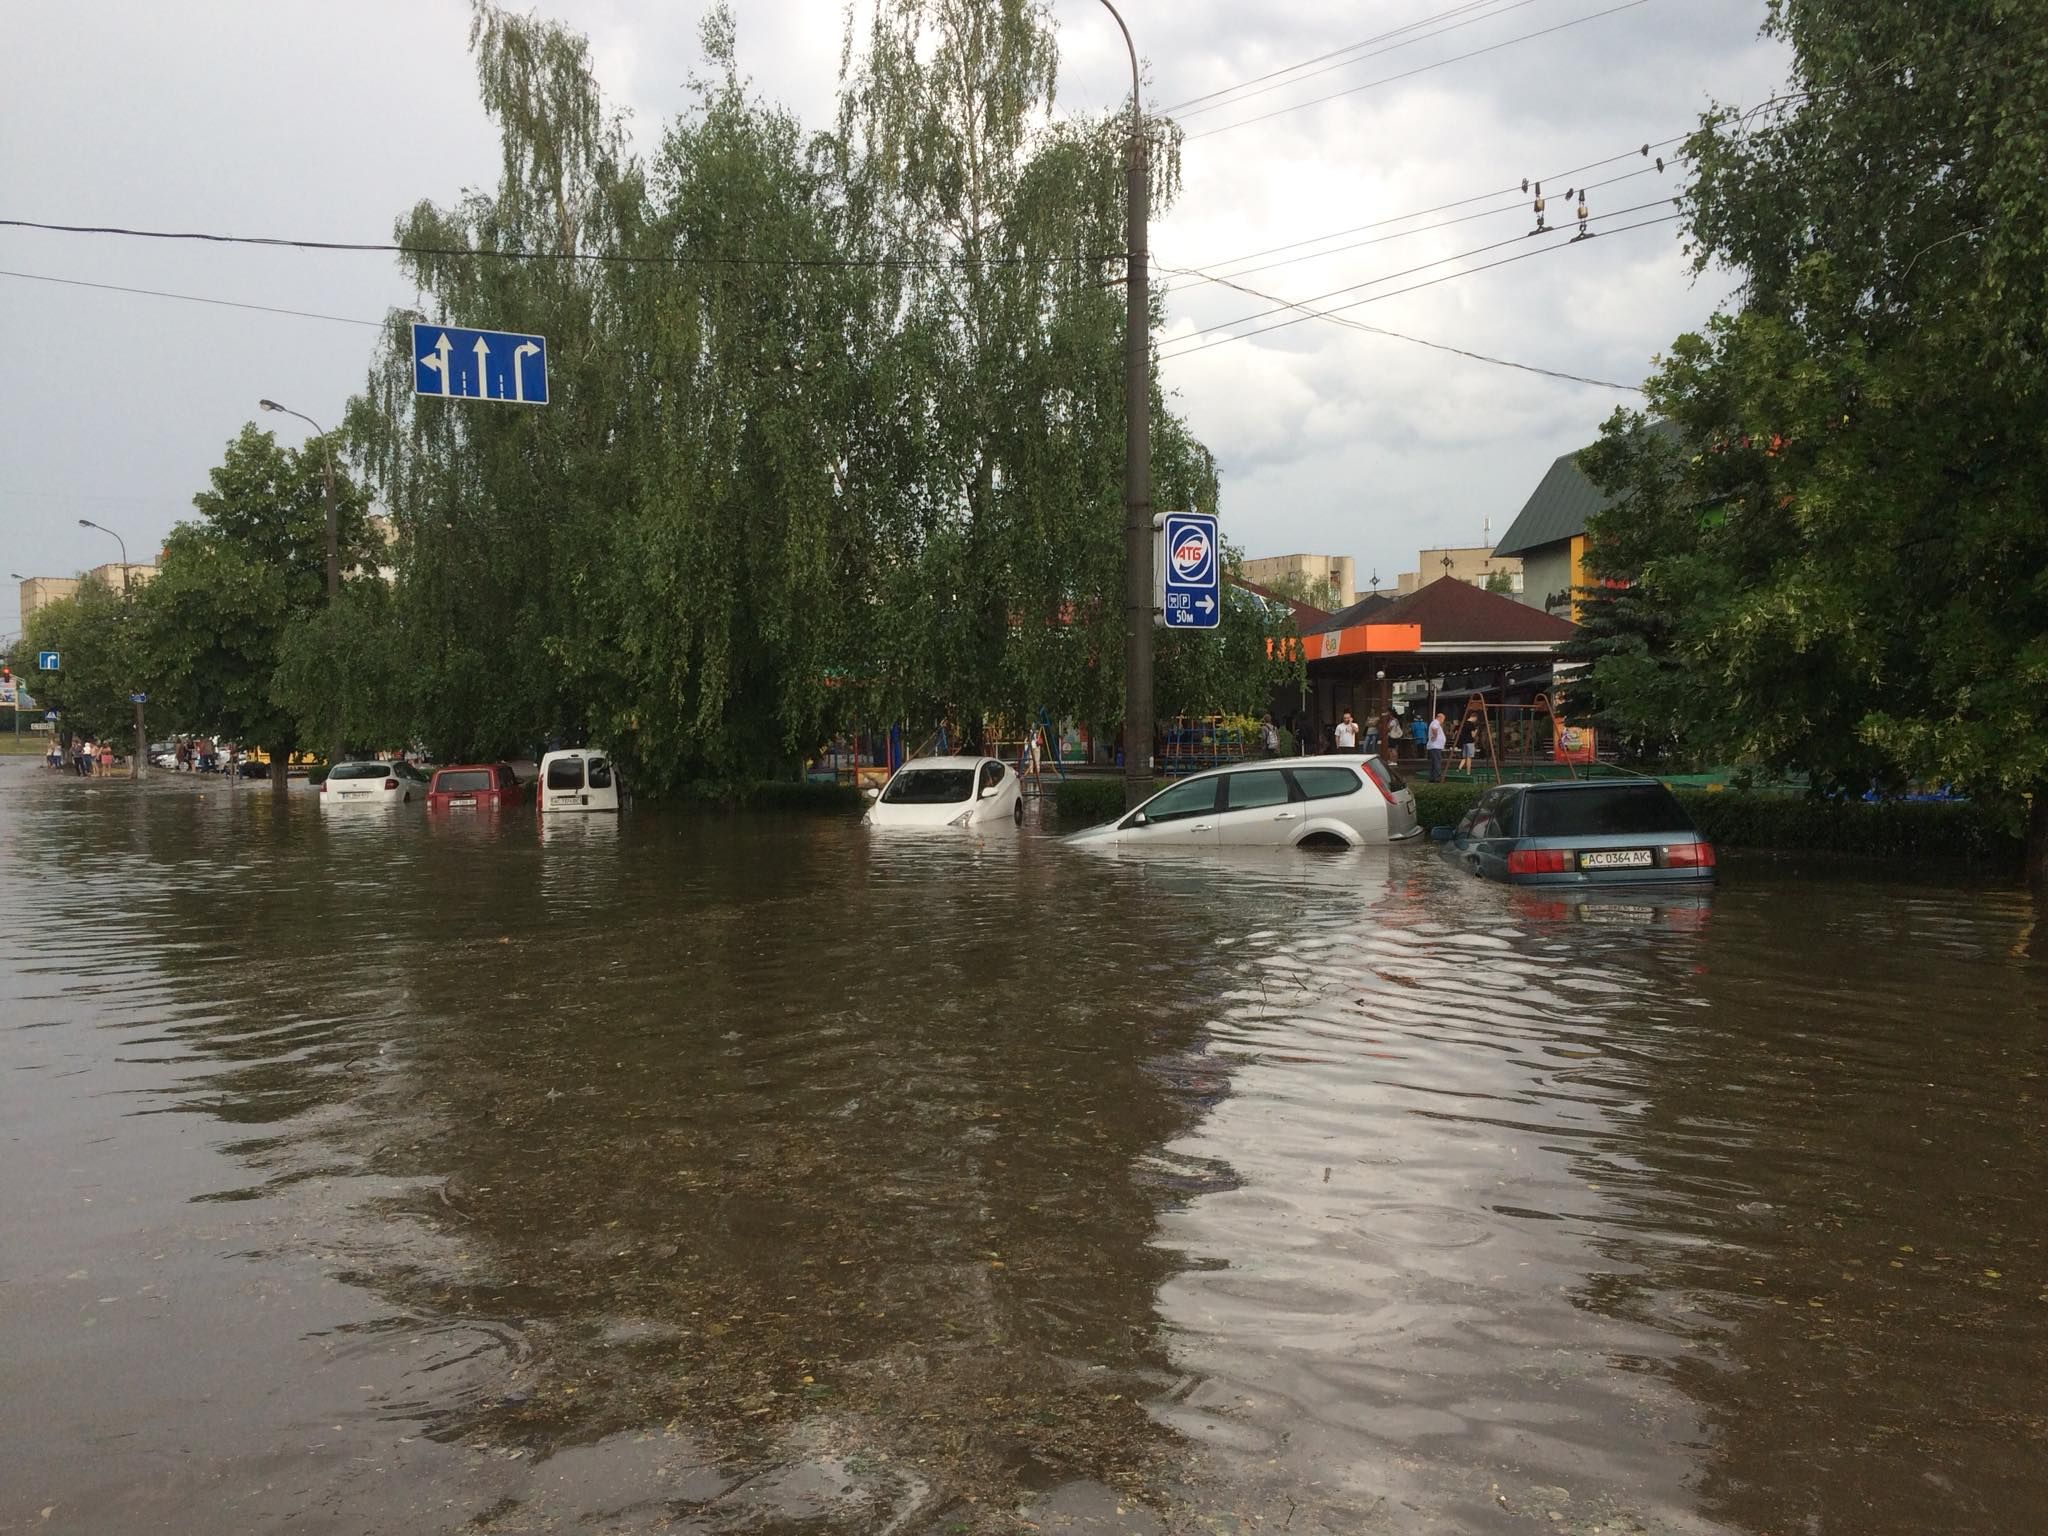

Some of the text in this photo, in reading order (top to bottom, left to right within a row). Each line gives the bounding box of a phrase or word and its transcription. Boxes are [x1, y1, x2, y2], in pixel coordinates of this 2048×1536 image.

[1175, 546, 1201, 560] АТБ
[1588, 852, 1648, 865] AC 0364 AK
